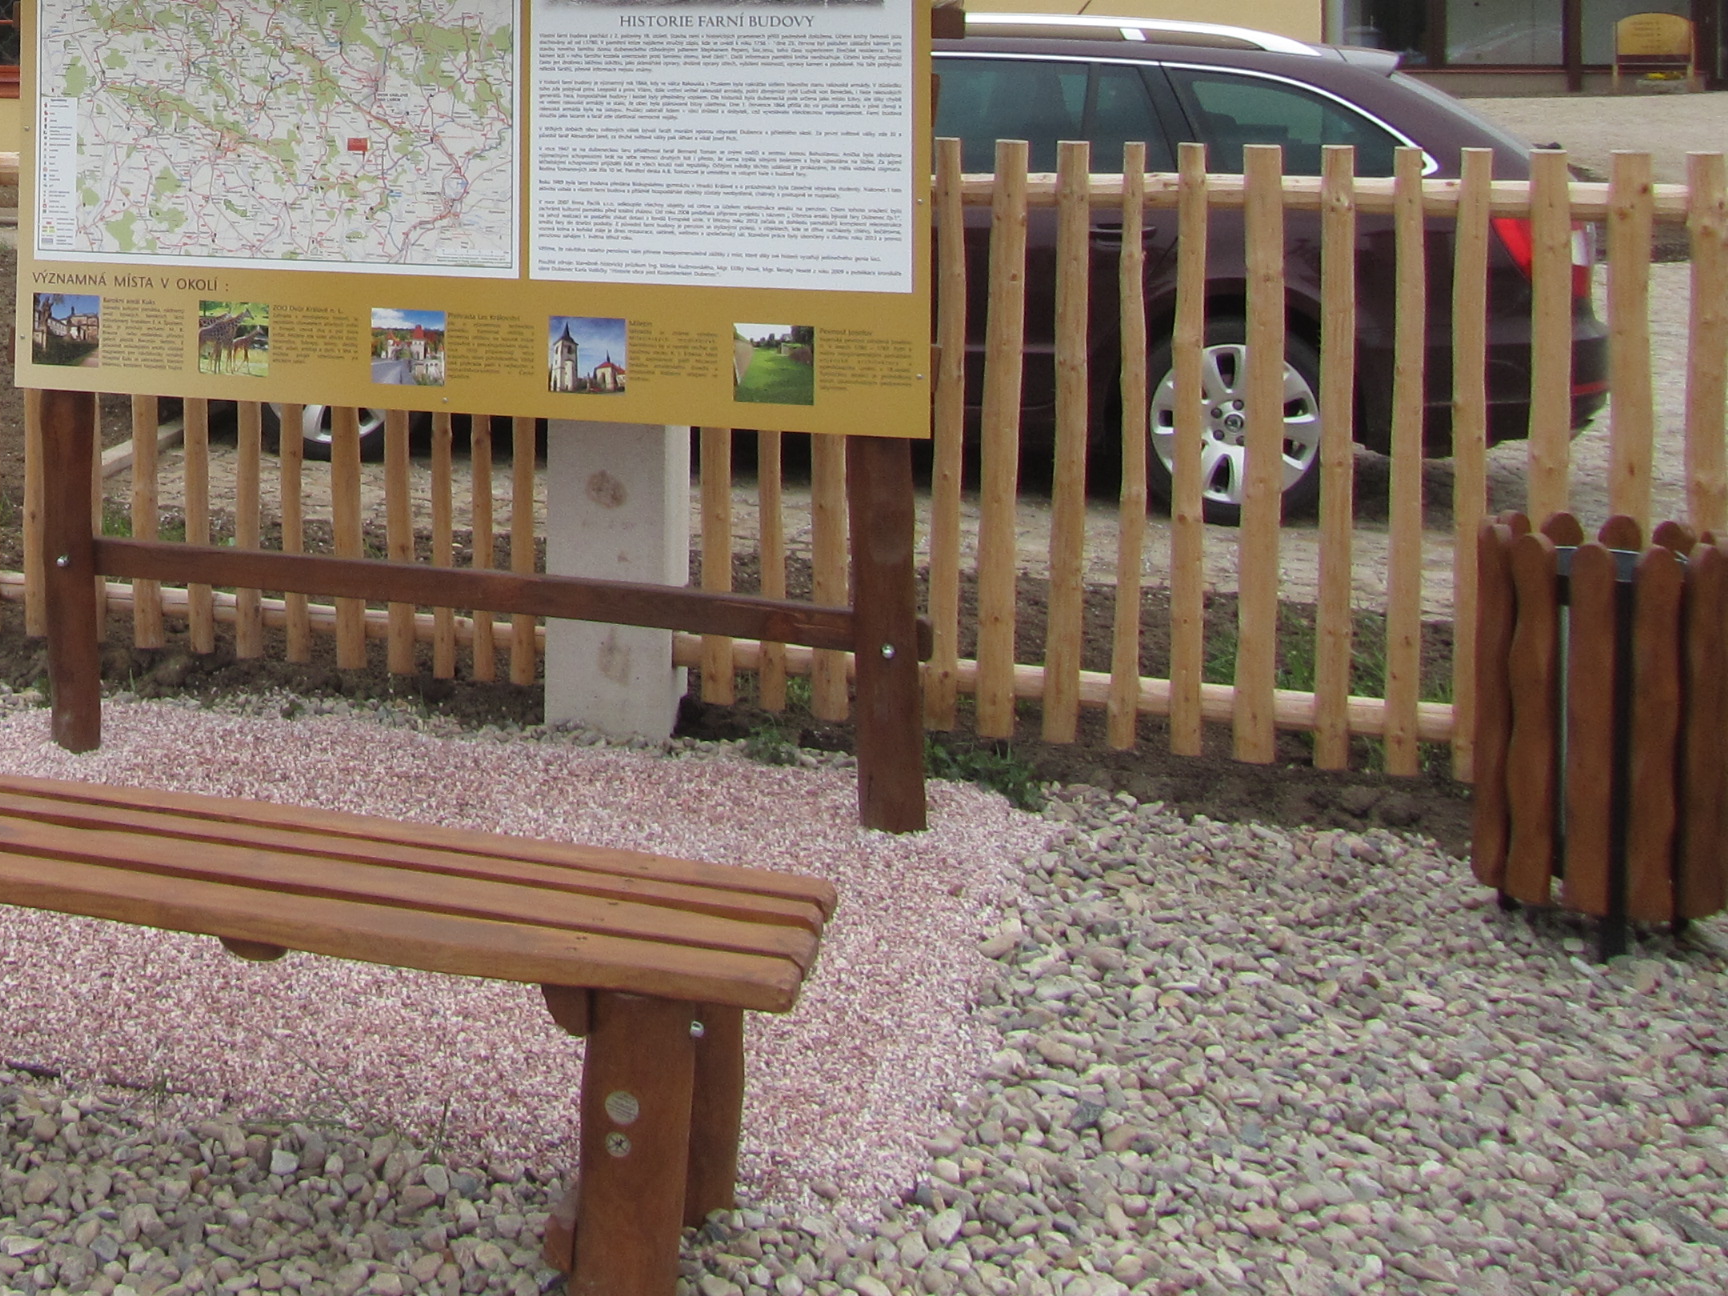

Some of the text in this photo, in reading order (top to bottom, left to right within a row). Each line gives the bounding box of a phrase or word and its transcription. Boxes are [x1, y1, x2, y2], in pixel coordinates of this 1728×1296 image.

[619, 11, 815, 28] HISTORIE FARNÍ BUDOVY
[32, 269, 106, 286] VÝZNAMNÁ
[114, 273, 153, 288] MÍSTA
[160, 277, 169, 289] V
[176, 276, 218, 291] OKOLÍ
